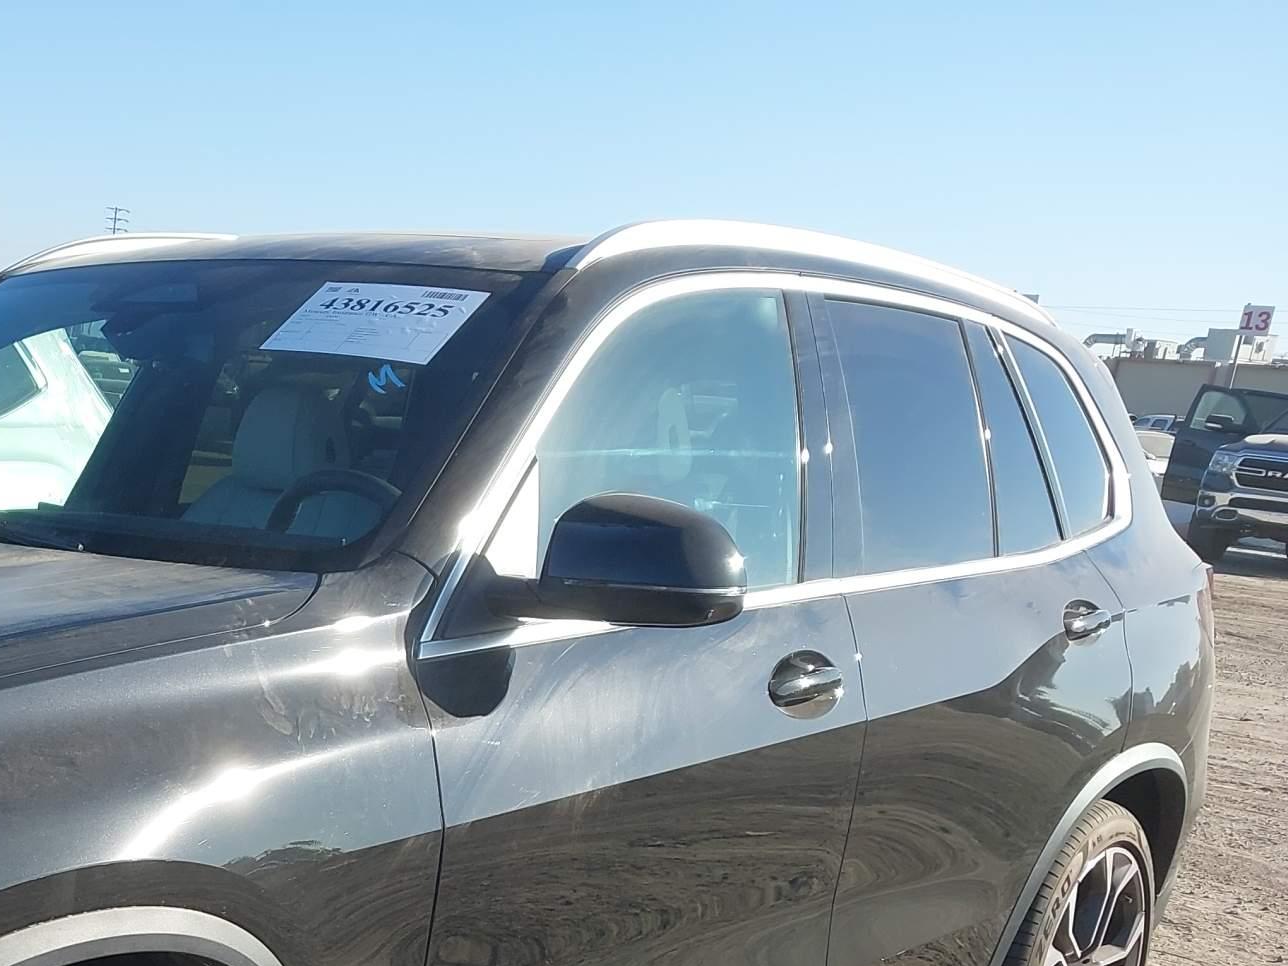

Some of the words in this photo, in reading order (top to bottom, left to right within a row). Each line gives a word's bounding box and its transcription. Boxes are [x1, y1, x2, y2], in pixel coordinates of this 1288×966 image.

[320, 297, 455, 319] 43816525
[1240, 310, 1272, 331] 13
[1035, 874, 1072, 963] ZERO
